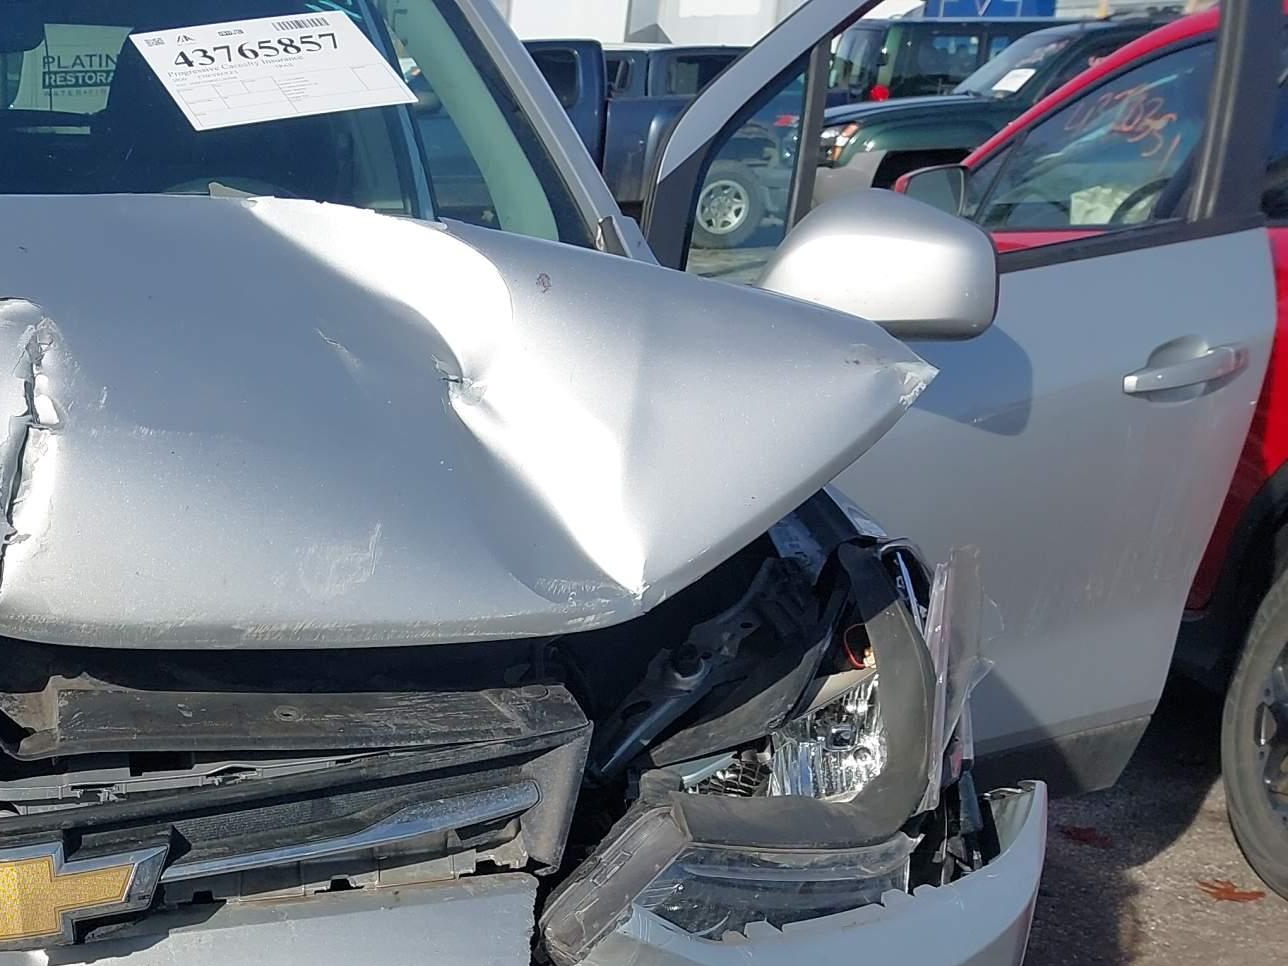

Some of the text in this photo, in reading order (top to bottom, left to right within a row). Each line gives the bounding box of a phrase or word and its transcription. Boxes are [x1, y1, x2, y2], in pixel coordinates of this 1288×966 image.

[173, 32, 340, 69] 43765857
[168, 66, 220, 79] Progressive
[261, 55, 304, 66] Insurance
